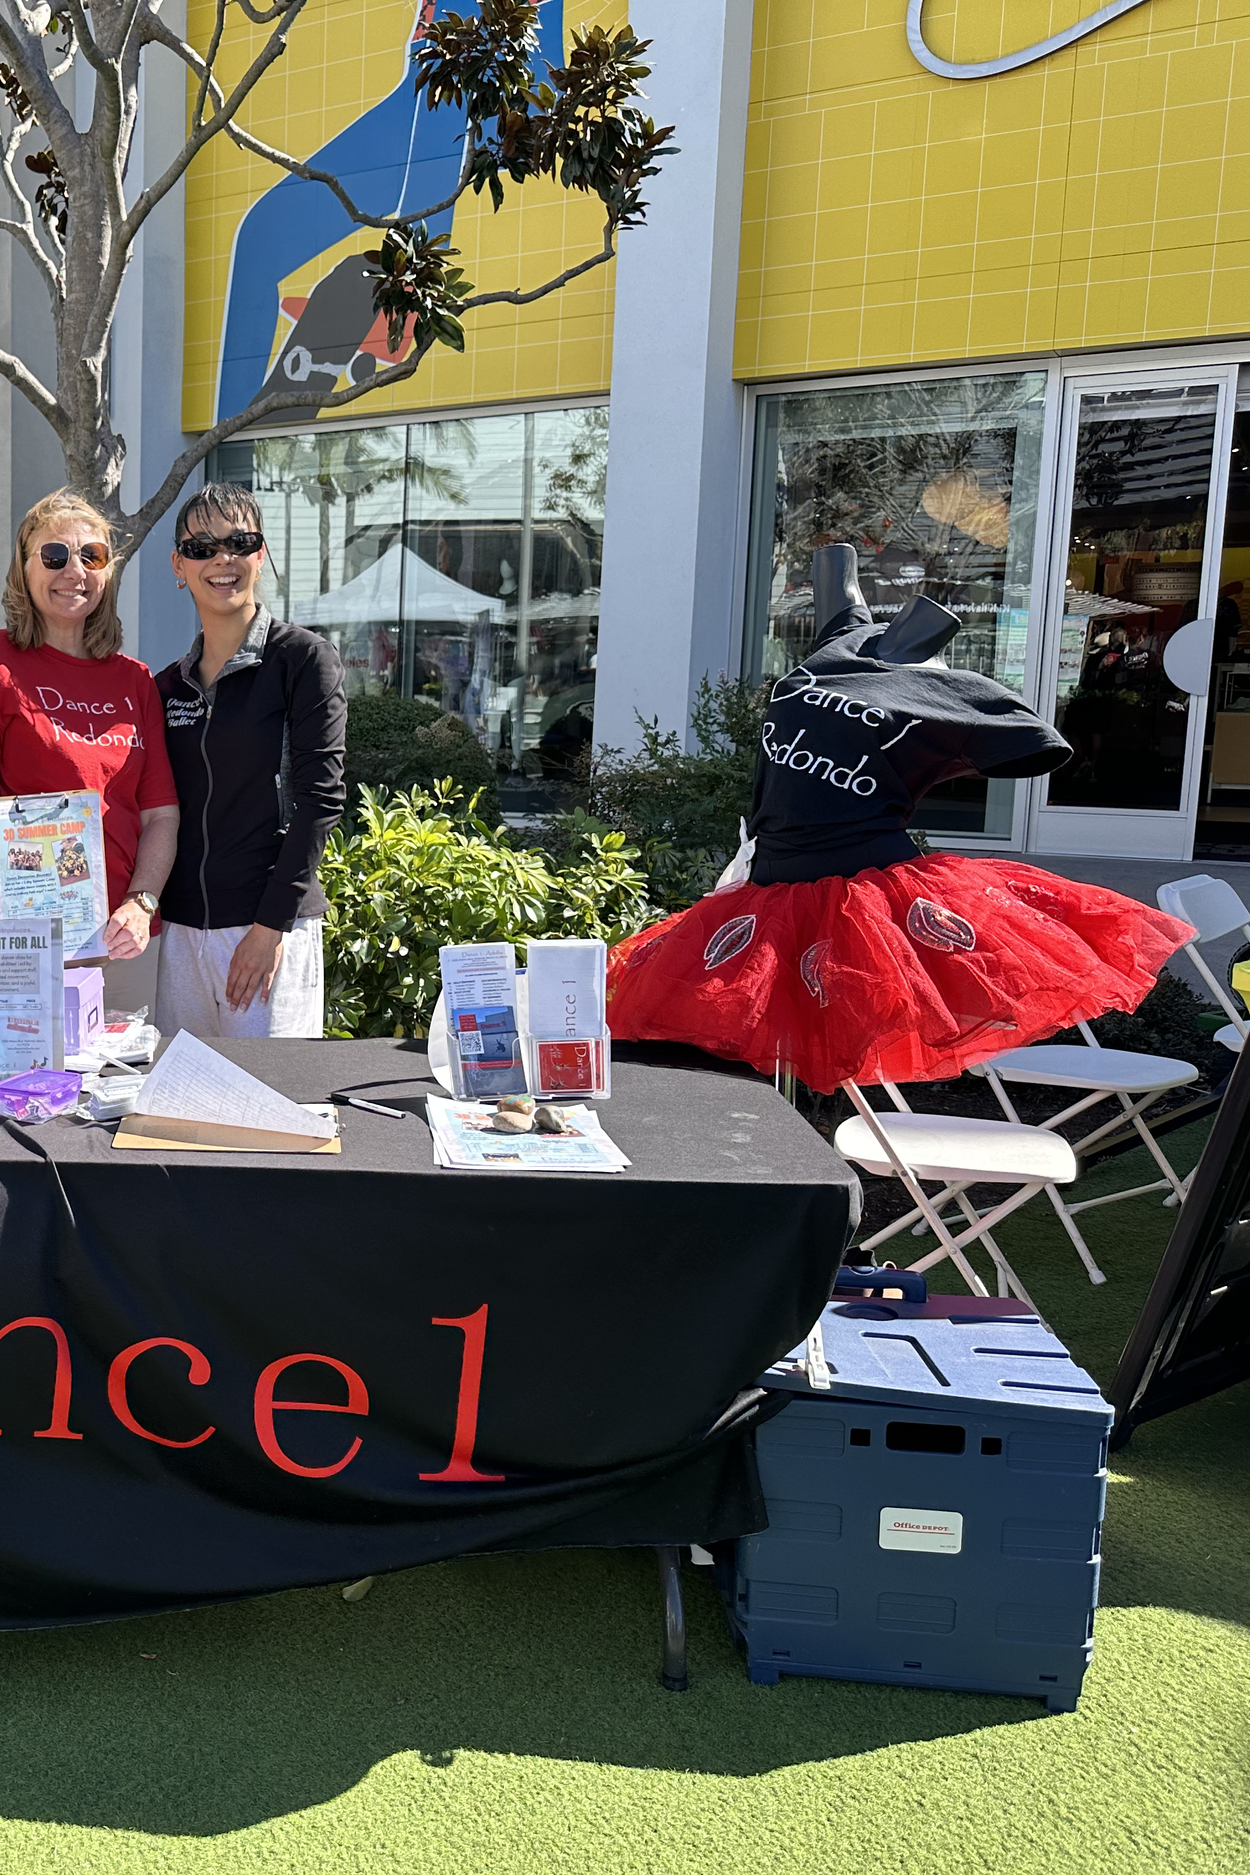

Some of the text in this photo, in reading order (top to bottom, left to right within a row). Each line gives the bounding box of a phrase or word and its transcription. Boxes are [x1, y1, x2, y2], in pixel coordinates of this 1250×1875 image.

[35, 686, 133, 715] Dance 1
[770, 665, 923, 750] Dance 1
[168, 717, 197, 728] Ballet
[3, 828, 15, 841] 3D
[17, 823, 58, 840] SUMMER
[59, 820, 86, 834] CAMP
[9, 936, 28, 950] FOR
[30, 936, 48, 949] ALL
[565, 994, 577, 1037] ance
[893, 1521, 921, 1530] Office
